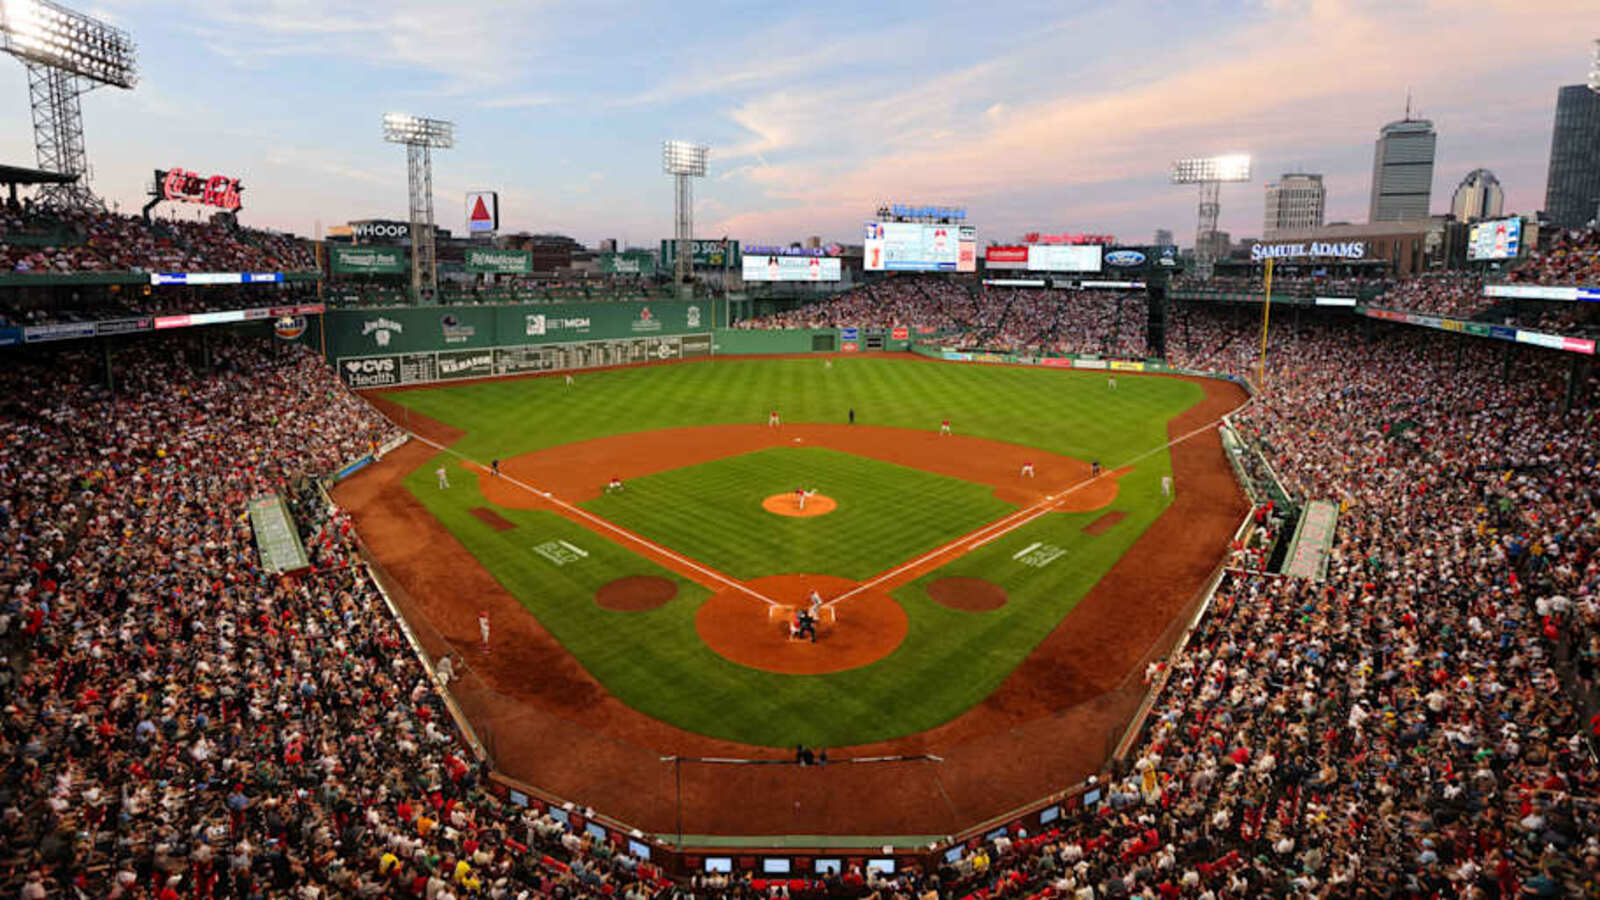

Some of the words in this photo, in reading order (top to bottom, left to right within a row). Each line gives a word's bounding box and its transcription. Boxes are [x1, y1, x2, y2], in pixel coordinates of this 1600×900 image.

[164, 168, 240, 208] Coca-Cola
[354, 224, 407, 236] WHOOP
[1251, 243, 1306, 260] SAMUEL
[1309, 242, 1364, 258] ADAMS
[363, 359, 394, 373] CVS
[350, 372, 394, 386] Health
